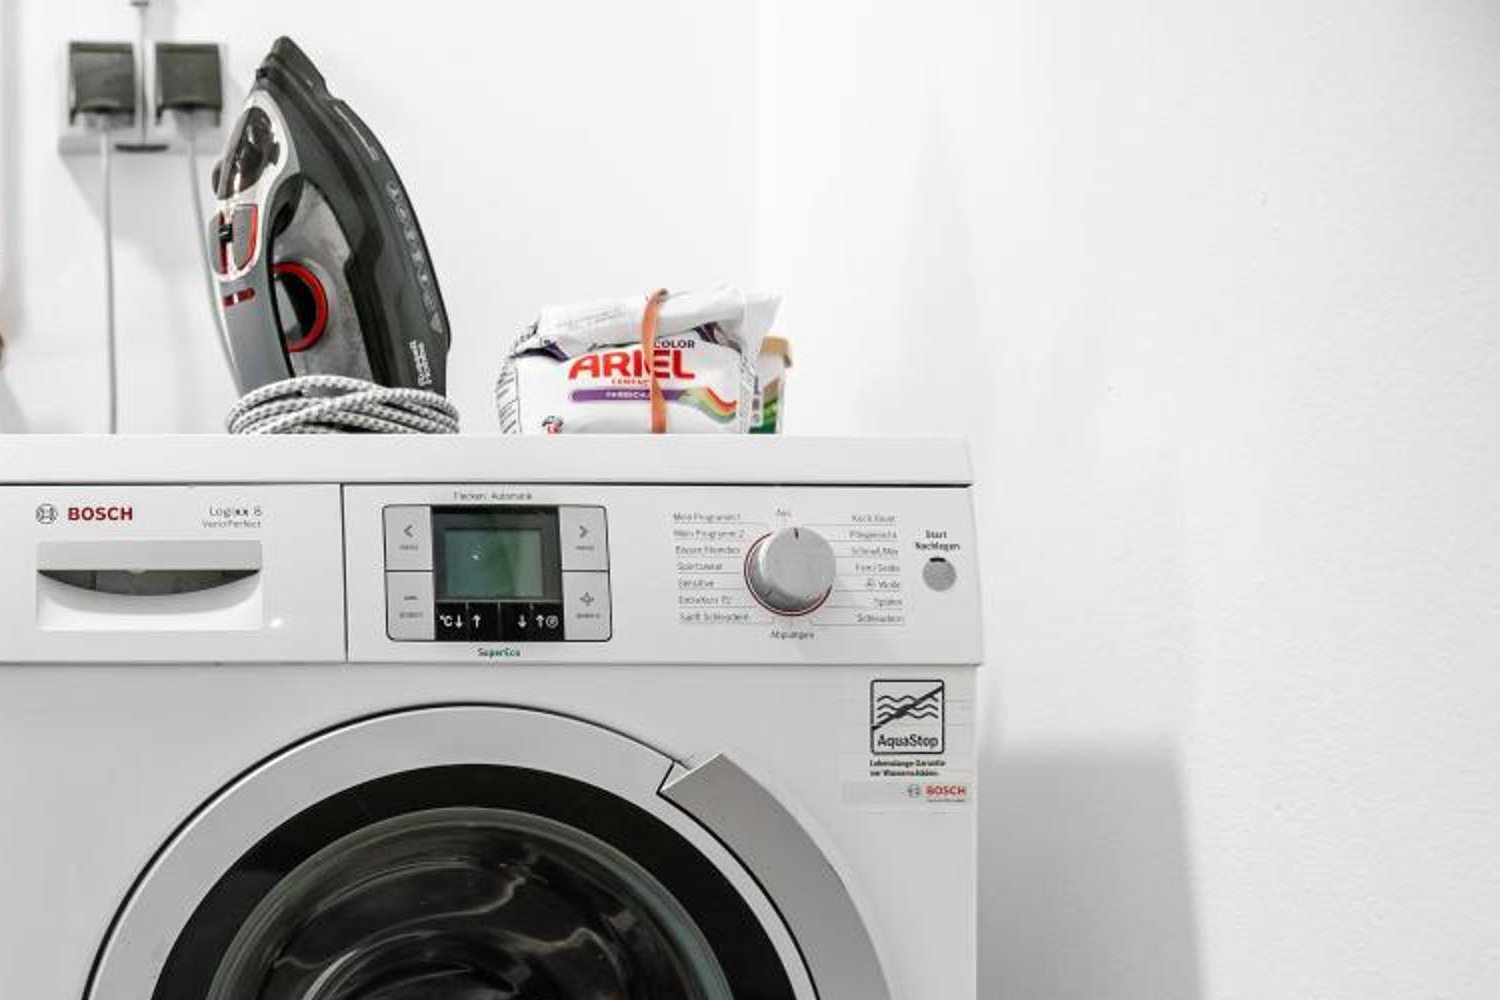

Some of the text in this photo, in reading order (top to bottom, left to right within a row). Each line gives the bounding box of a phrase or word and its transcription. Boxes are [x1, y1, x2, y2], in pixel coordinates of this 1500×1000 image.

[654, 339, 695, 348] COLOR
[568, 349, 695, 380] ARIEL
[67, 507, 133, 521] BOSCH
[877, 733, 939, 749] AquaStop
[925, 785, 966, 796] BOSCH
